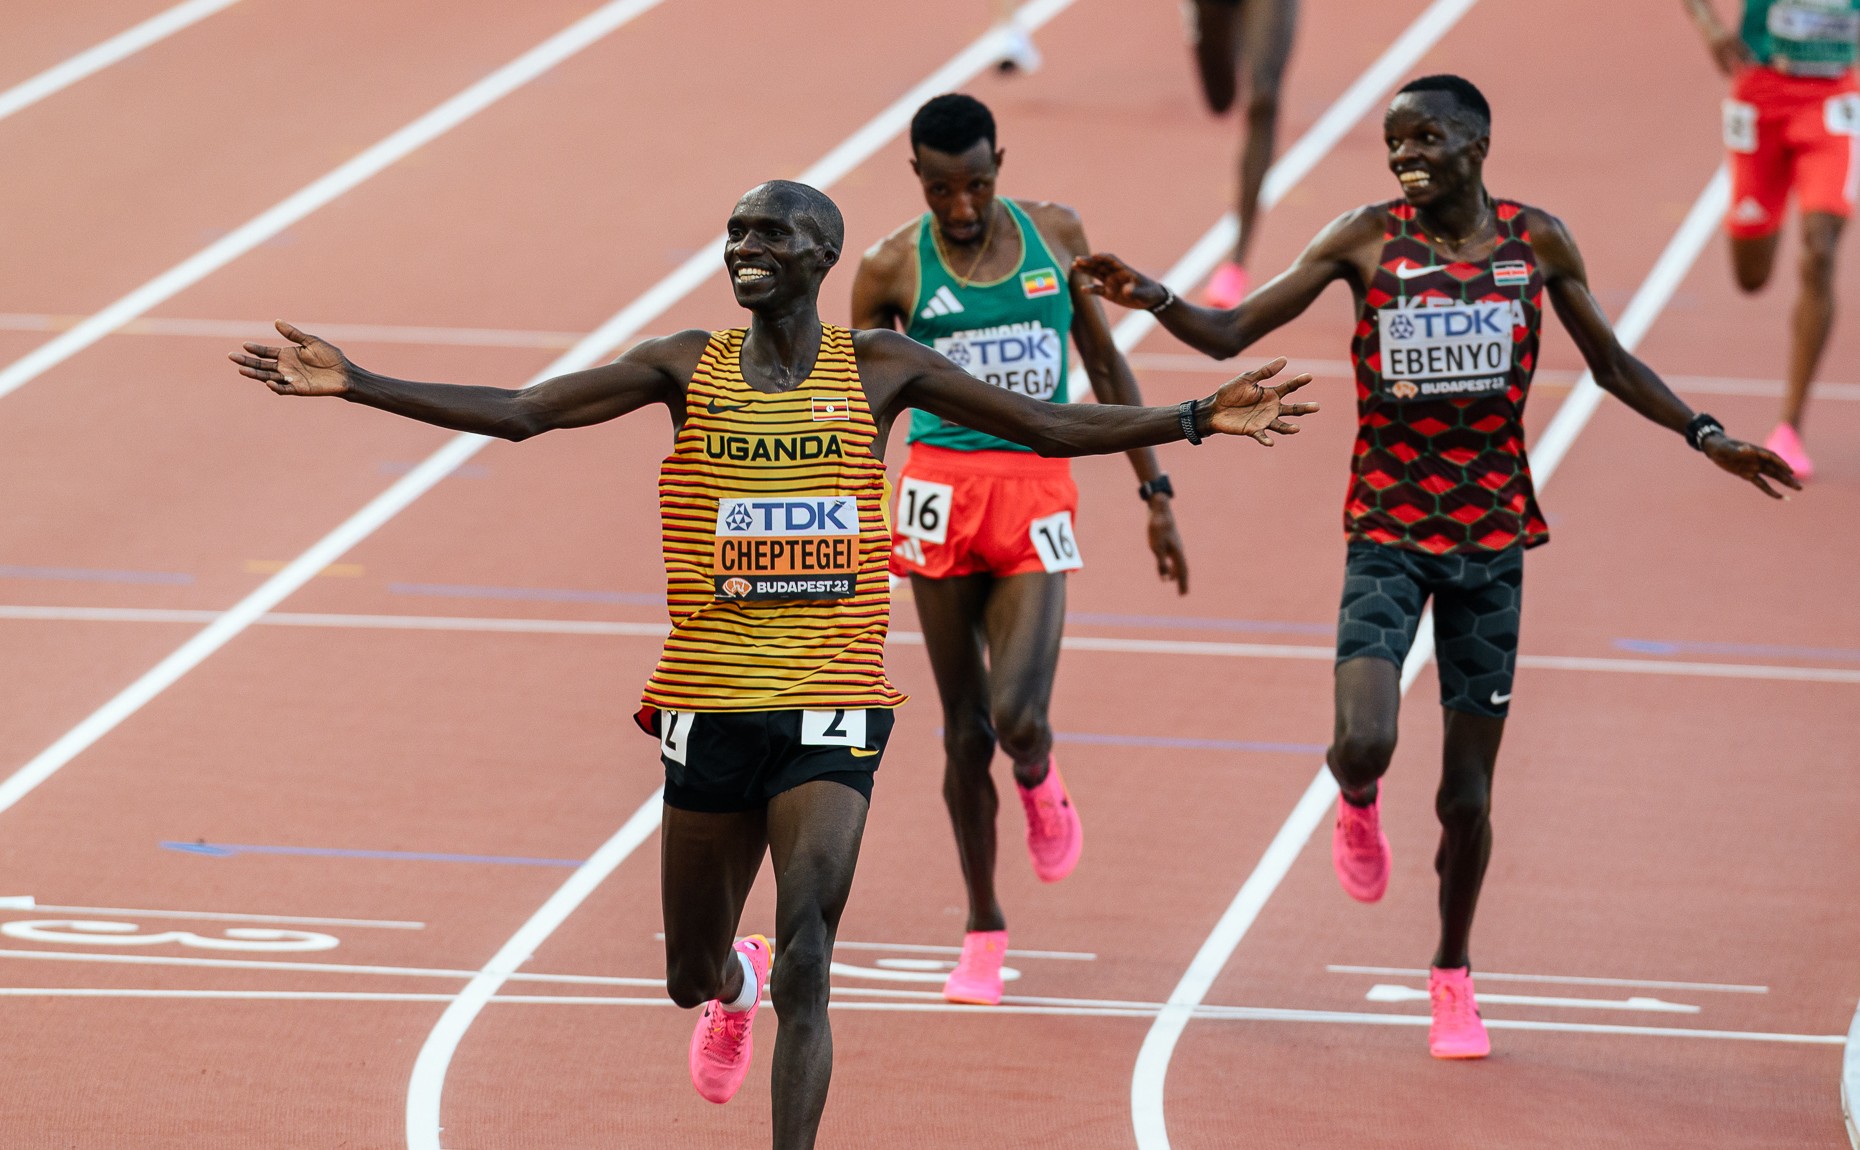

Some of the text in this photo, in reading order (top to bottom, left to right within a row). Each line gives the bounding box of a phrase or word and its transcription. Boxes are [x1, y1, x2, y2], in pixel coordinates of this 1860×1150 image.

[1414, 307, 1502, 338] TDK
[970, 333, 1052, 365] TDK
[1390, 342, 1502, 375] EBENYO
[705, 434, 843, 462] UGANDA
[752, 501, 848, 531] TDK
[907, 488, 940, 531] 16
[721, 539, 852, 571] CHEPTEGEI
[1039, 522, 1074, 561] 16
[822, 709, 848, 737] 2
